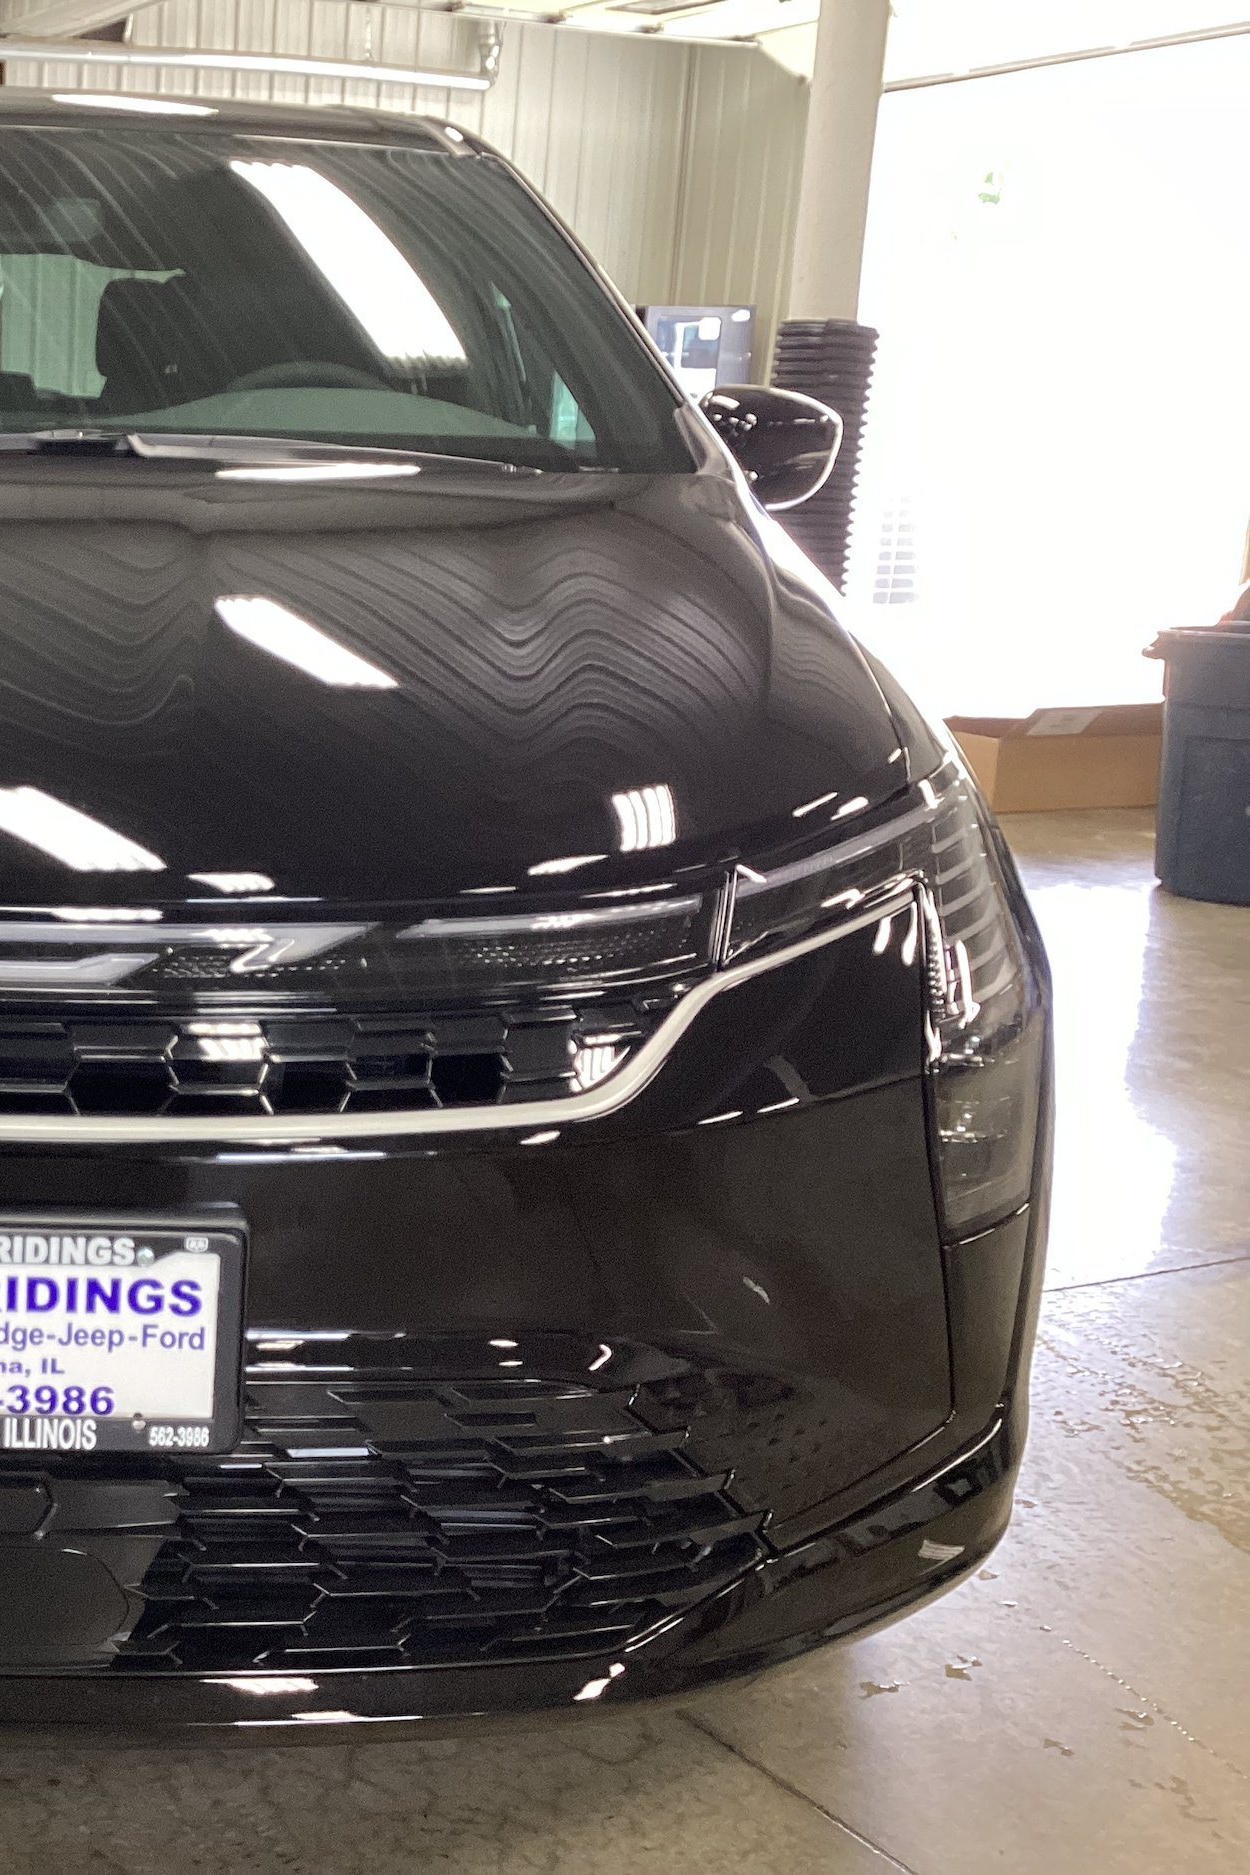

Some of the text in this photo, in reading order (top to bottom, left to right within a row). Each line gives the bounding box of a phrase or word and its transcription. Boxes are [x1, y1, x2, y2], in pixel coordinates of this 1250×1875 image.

[40, 1358, 66, 1375] IL
[3, 1418, 98, 1450] ILLINOIS
[149, 1426, 210, 1448] 562-3986
